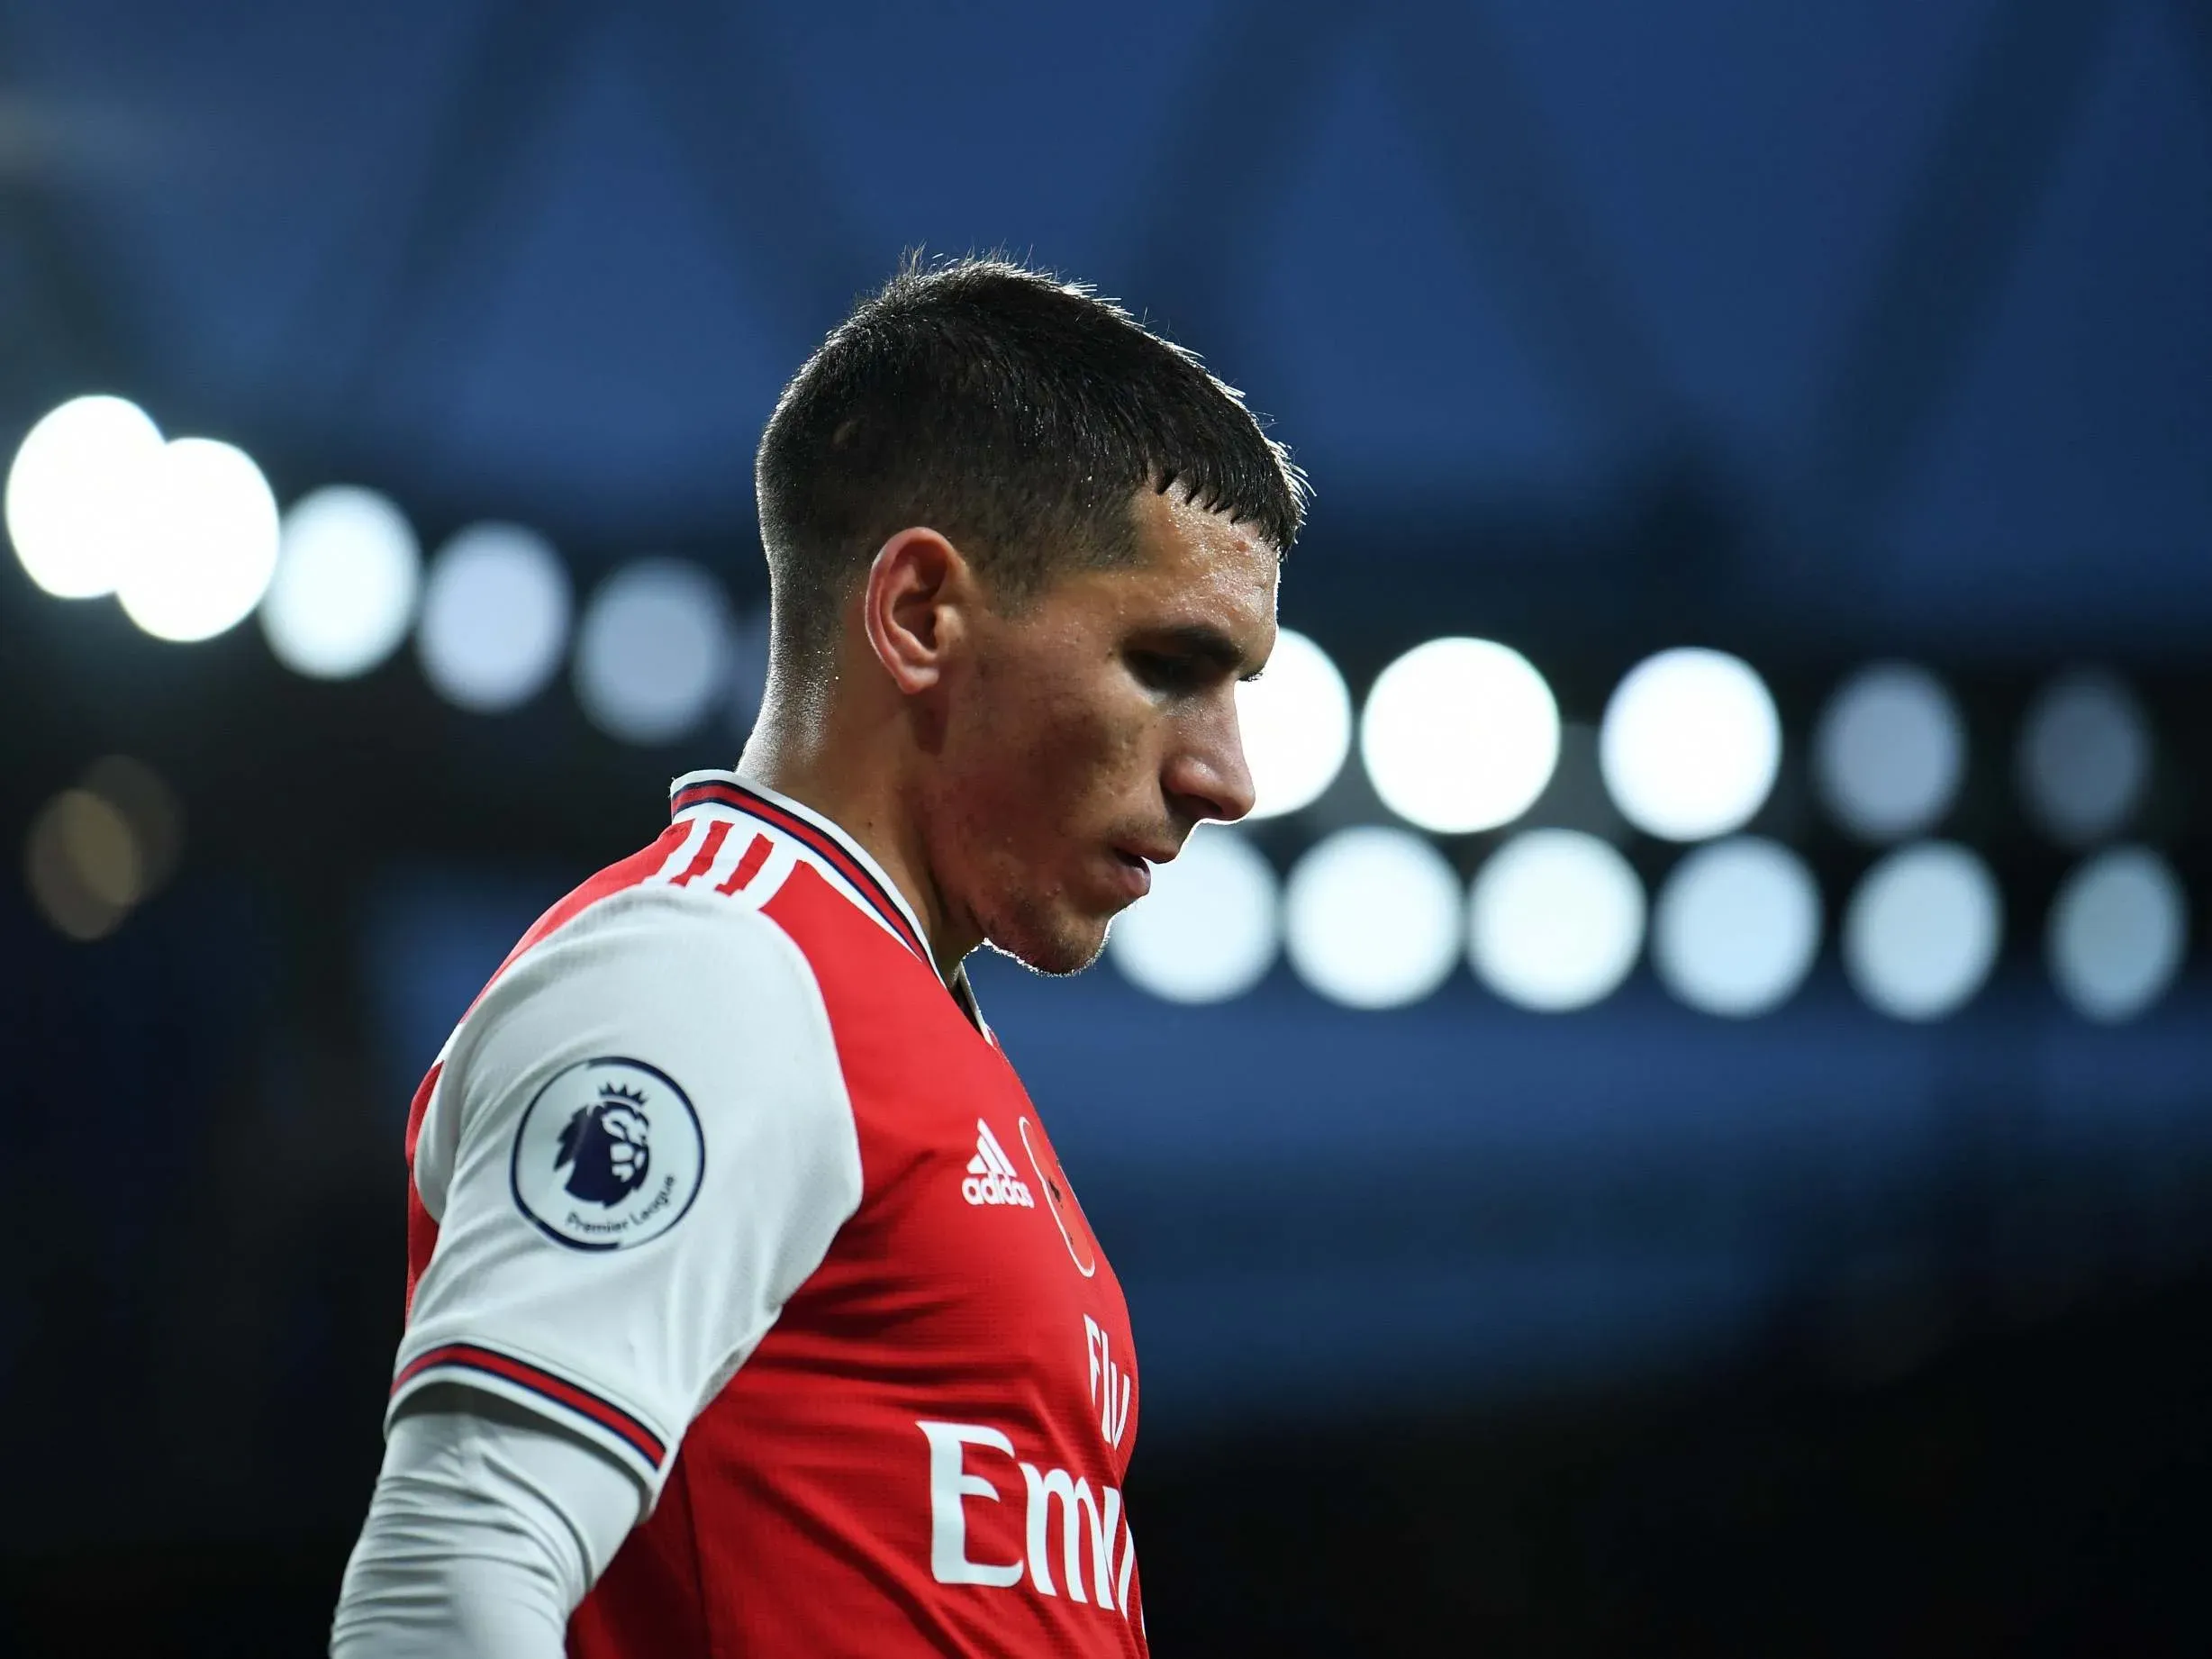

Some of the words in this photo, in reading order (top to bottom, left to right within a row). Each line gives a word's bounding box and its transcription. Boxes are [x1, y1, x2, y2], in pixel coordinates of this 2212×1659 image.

[566, 1211, 629, 1234] Premier
[630, 1174, 676, 1226] League
[962, 1171, 1035, 1209] adidas
